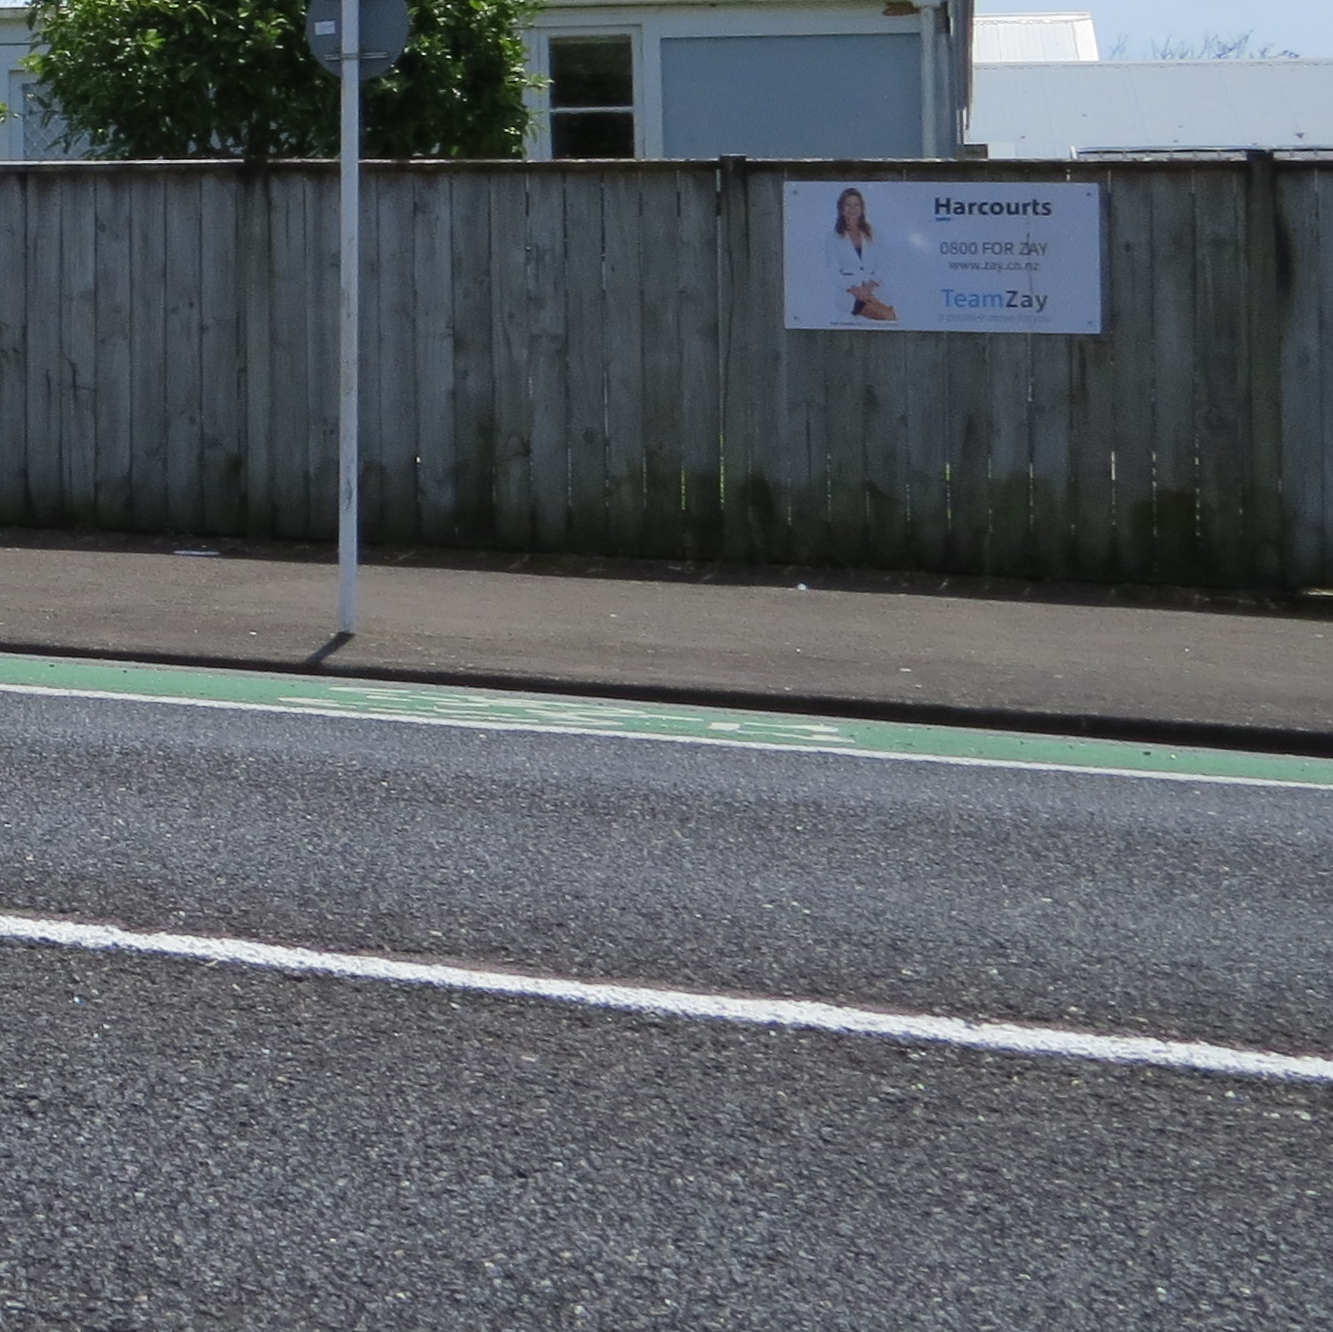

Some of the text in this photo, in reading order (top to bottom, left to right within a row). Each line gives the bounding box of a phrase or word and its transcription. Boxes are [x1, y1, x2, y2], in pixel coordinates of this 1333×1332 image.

[935, 197, 1052, 216] Harcourts
[939, 242, 1048, 256] 0800 FOR ZAY
[949, 261, 1040, 273] www.zay.co.nz
